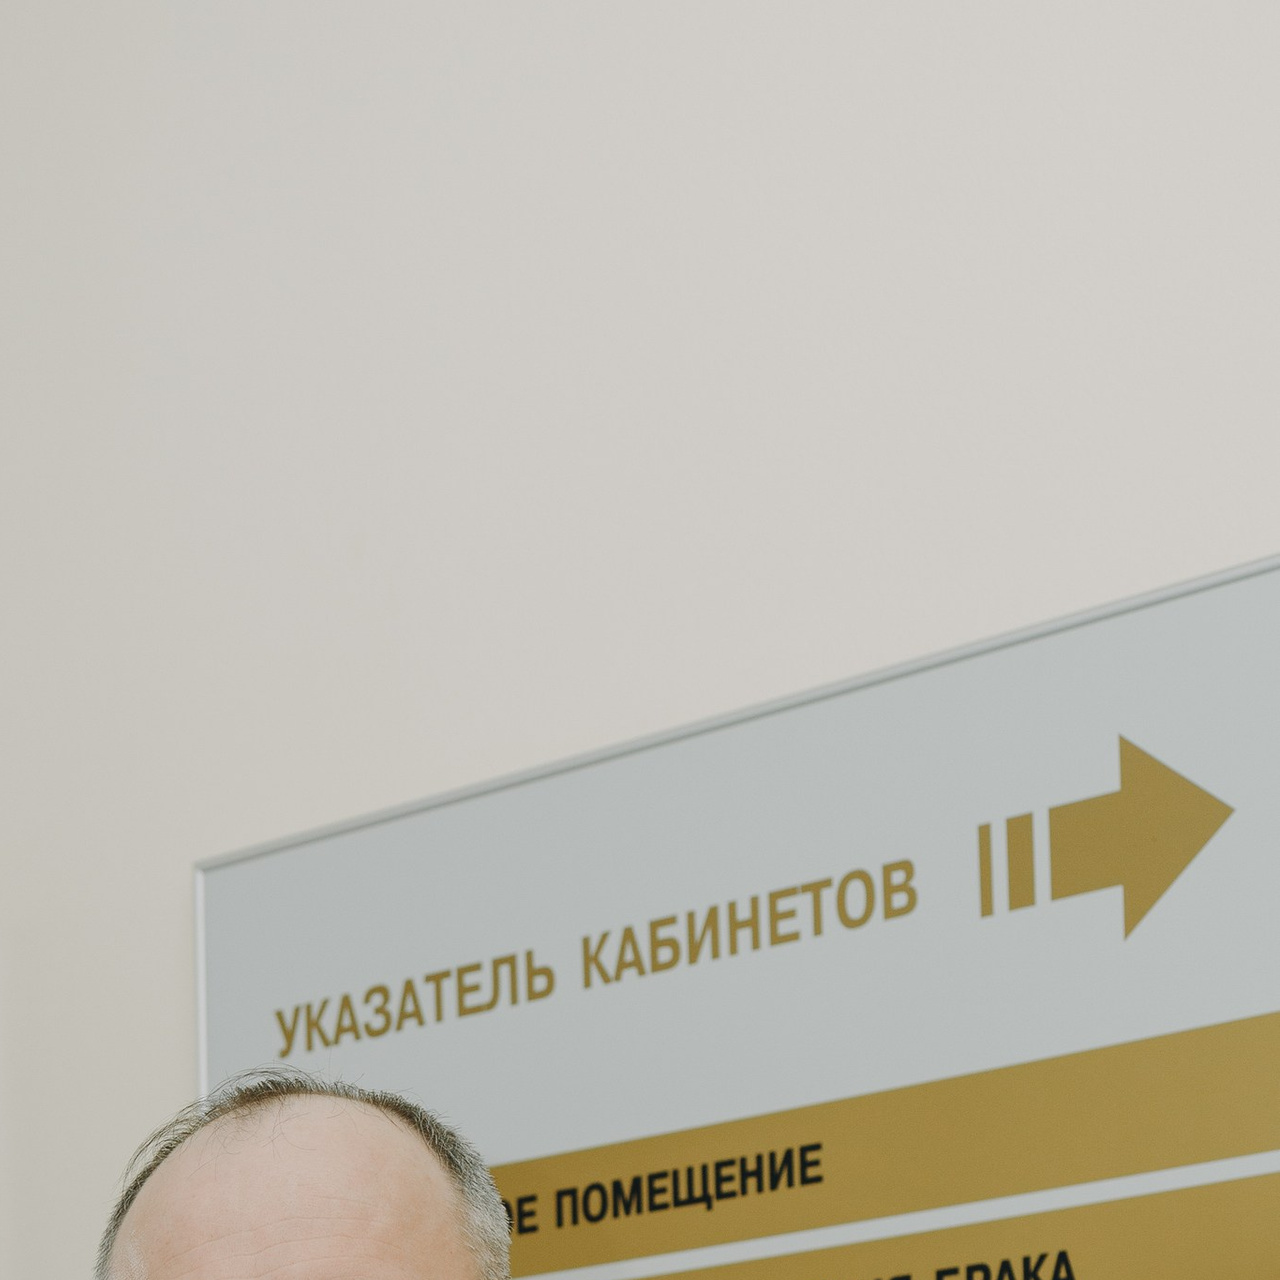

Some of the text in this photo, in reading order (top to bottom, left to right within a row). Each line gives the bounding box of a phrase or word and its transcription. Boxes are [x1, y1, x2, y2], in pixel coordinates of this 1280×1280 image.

[274, 860, 918, 1058] УКАЗАТЕЛЬ КАБИНЕТОВ
[554, 1141, 825, 1230] ПОМЕЩЕНИЕ
